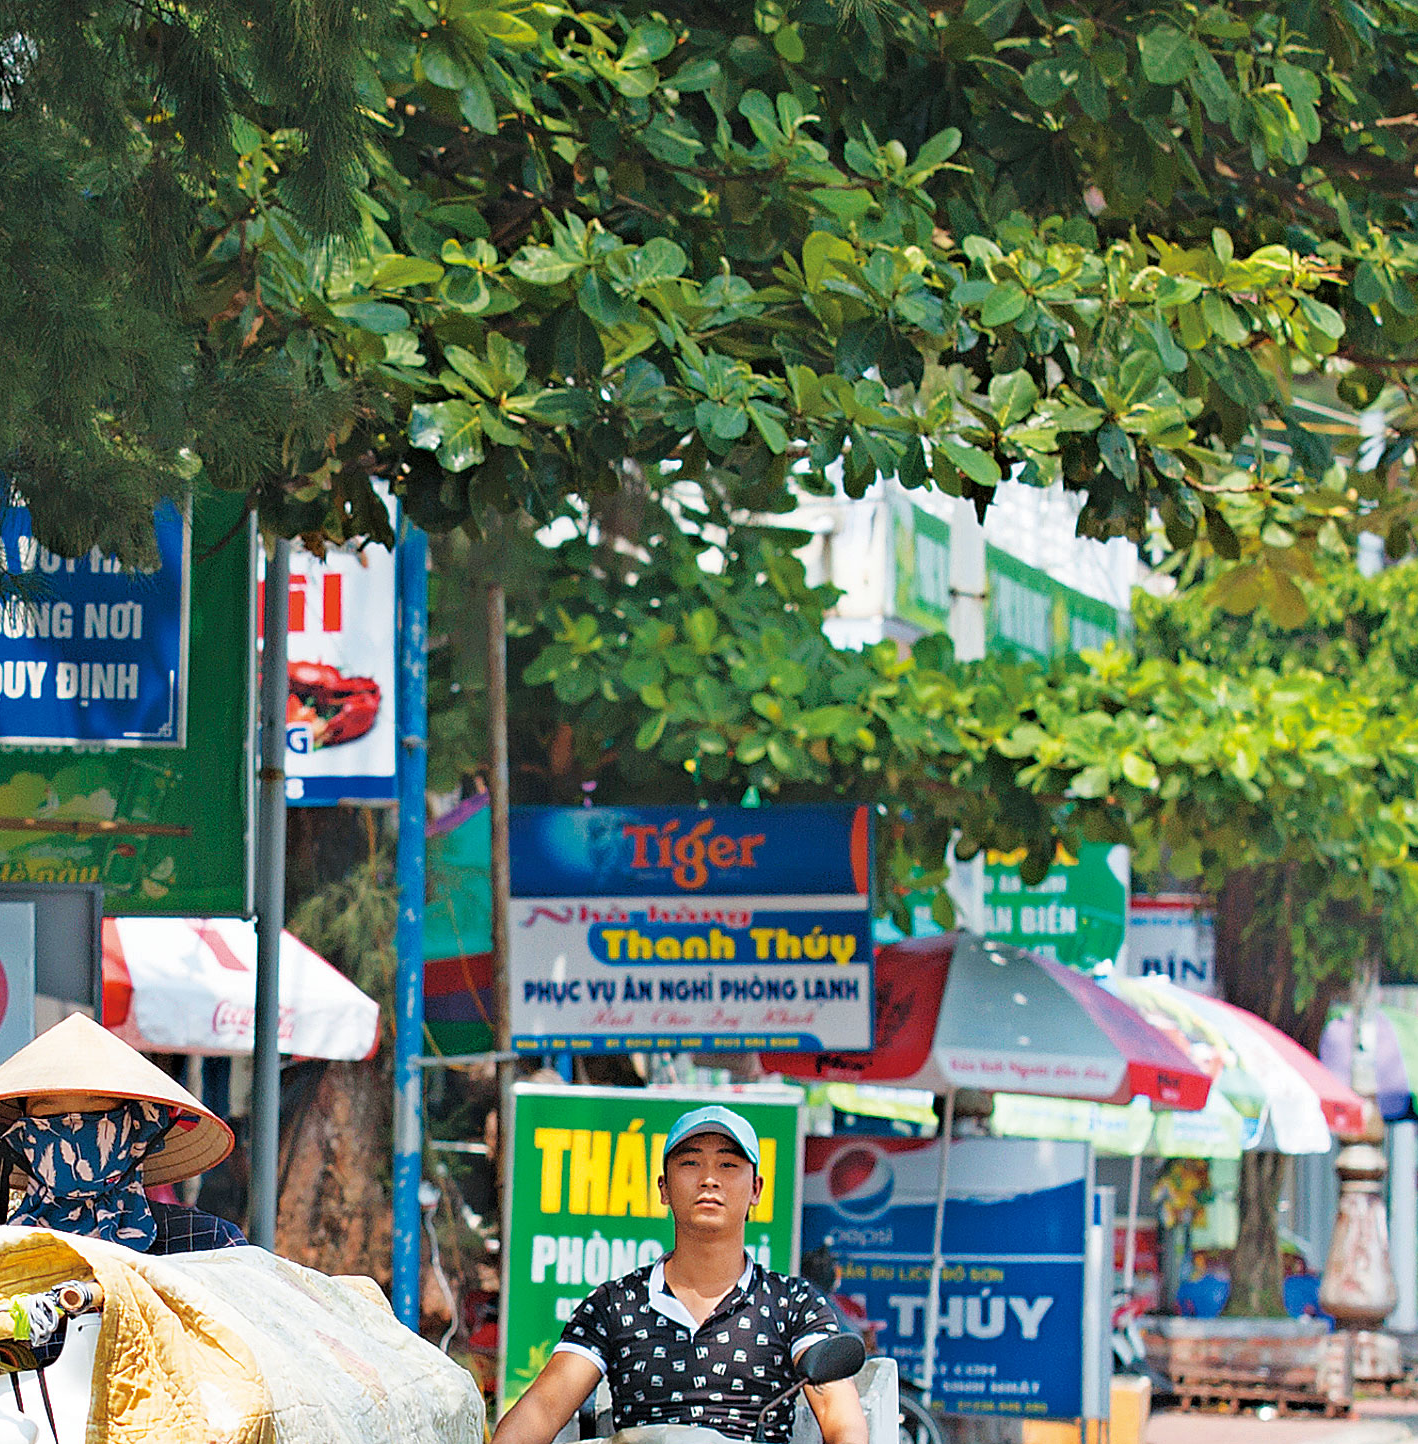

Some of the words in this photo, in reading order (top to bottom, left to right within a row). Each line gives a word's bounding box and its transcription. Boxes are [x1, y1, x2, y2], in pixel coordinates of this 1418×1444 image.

[84, 600, 143, 639] NƠI
[56, 662, 138, 707] ĐỊNH
[623, 819, 766, 890] Tiger
[601, 929, 736, 960] Thanh
[750, 926, 857, 965] Thúy
[523, 978, 581, 1008] PHỤC
[587, 978, 617, 1008] VỤ
[720, 974, 798, 1002] PHÒNG
[803, 978, 859, 1007] LẠNH
[888, 1286, 1054, 1339] THÚY
